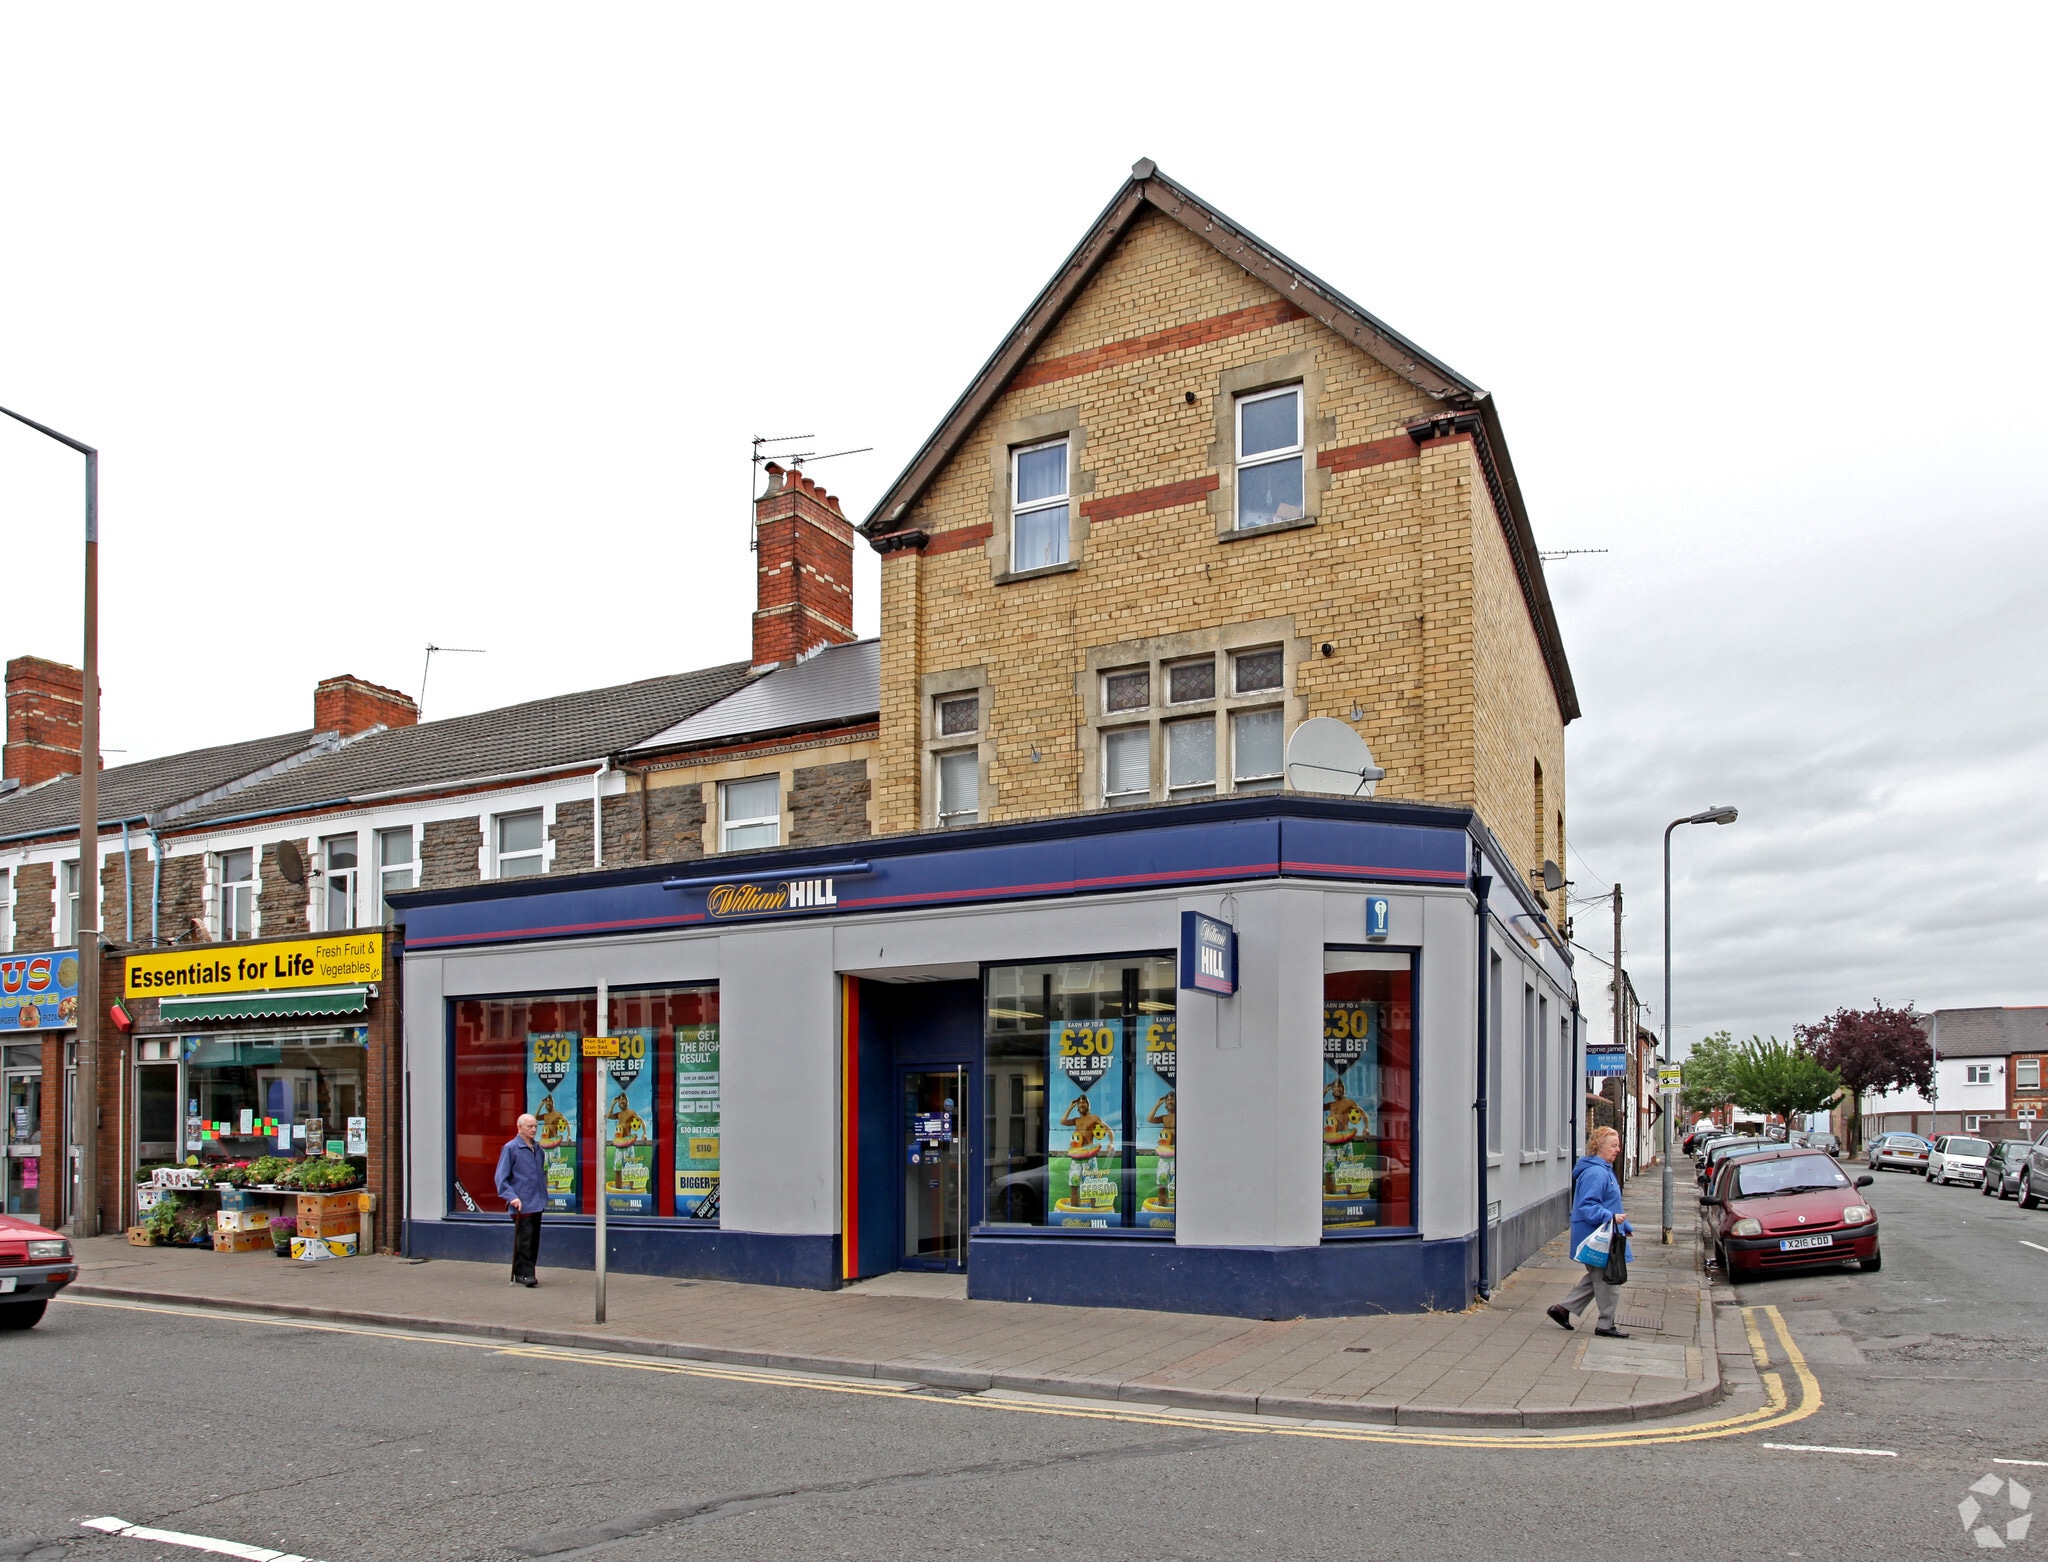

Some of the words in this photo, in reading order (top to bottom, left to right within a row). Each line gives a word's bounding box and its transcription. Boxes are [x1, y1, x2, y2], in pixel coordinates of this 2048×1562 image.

[706, 882, 790, 916] William
[789, 879, 837, 907] HILL
[1201, 919, 1227, 947] William
[316, 944, 342, 959] Fresh
[344, 942, 366, 957] Fruit
[367, 941, 375, 955] &
[1201, 945, 1224, 978] HILL
[131, 962, 232, 989] Essentials
[238, 958, 268, 980] for
[274, 953, 314, 978] Life
[320, 960, 371, 979] Vegetables
[0, 993, 59, 1008] OUSE
[697, 1030, 715, 1041] GET
[1059, 1027, 1114, 1056] £30
[533, 1039, 571, 1062] £30
[607, 1035, 645, 1060] 30
[680, 1042, 696, 1052] THE
[1324, 1039, 1342, 1051] REE
[1346, 1039, 1368, 1052] BET
[628, 1059, 645, 1070] BET
[680, 1053, 711, 1064] RESULT.
[1059, 1056, 1086, 1069] FREE
[1091, 1055, 1114, 1069] BET
[1146, 1052, 1175, 1066] FREE
[533, 1062, 552, 1073] FREE
[554, 1062, 571, 1073] BET
[681, 1126, 691, 1134] £10
[692, 1126, 702, 1134] BET
[696, 1144, 712, 1153] £110
[680, 1176, 710, 1189] BIGGER
[1335, 1168, 1373, 1184] SEASON
[1080, 1183, 1117, 1198] SEASON
[461, 1191, 475, 1211] 20p
[630, 1199, 642, 1208] HILL
[698, 1200, 712, 1218] DEBIT
[1347, 1206, 1364, 1216] HILL
[1091, 1219, 1107, 1228] HILL
[1788, 1239, 1809, 1248] X216
